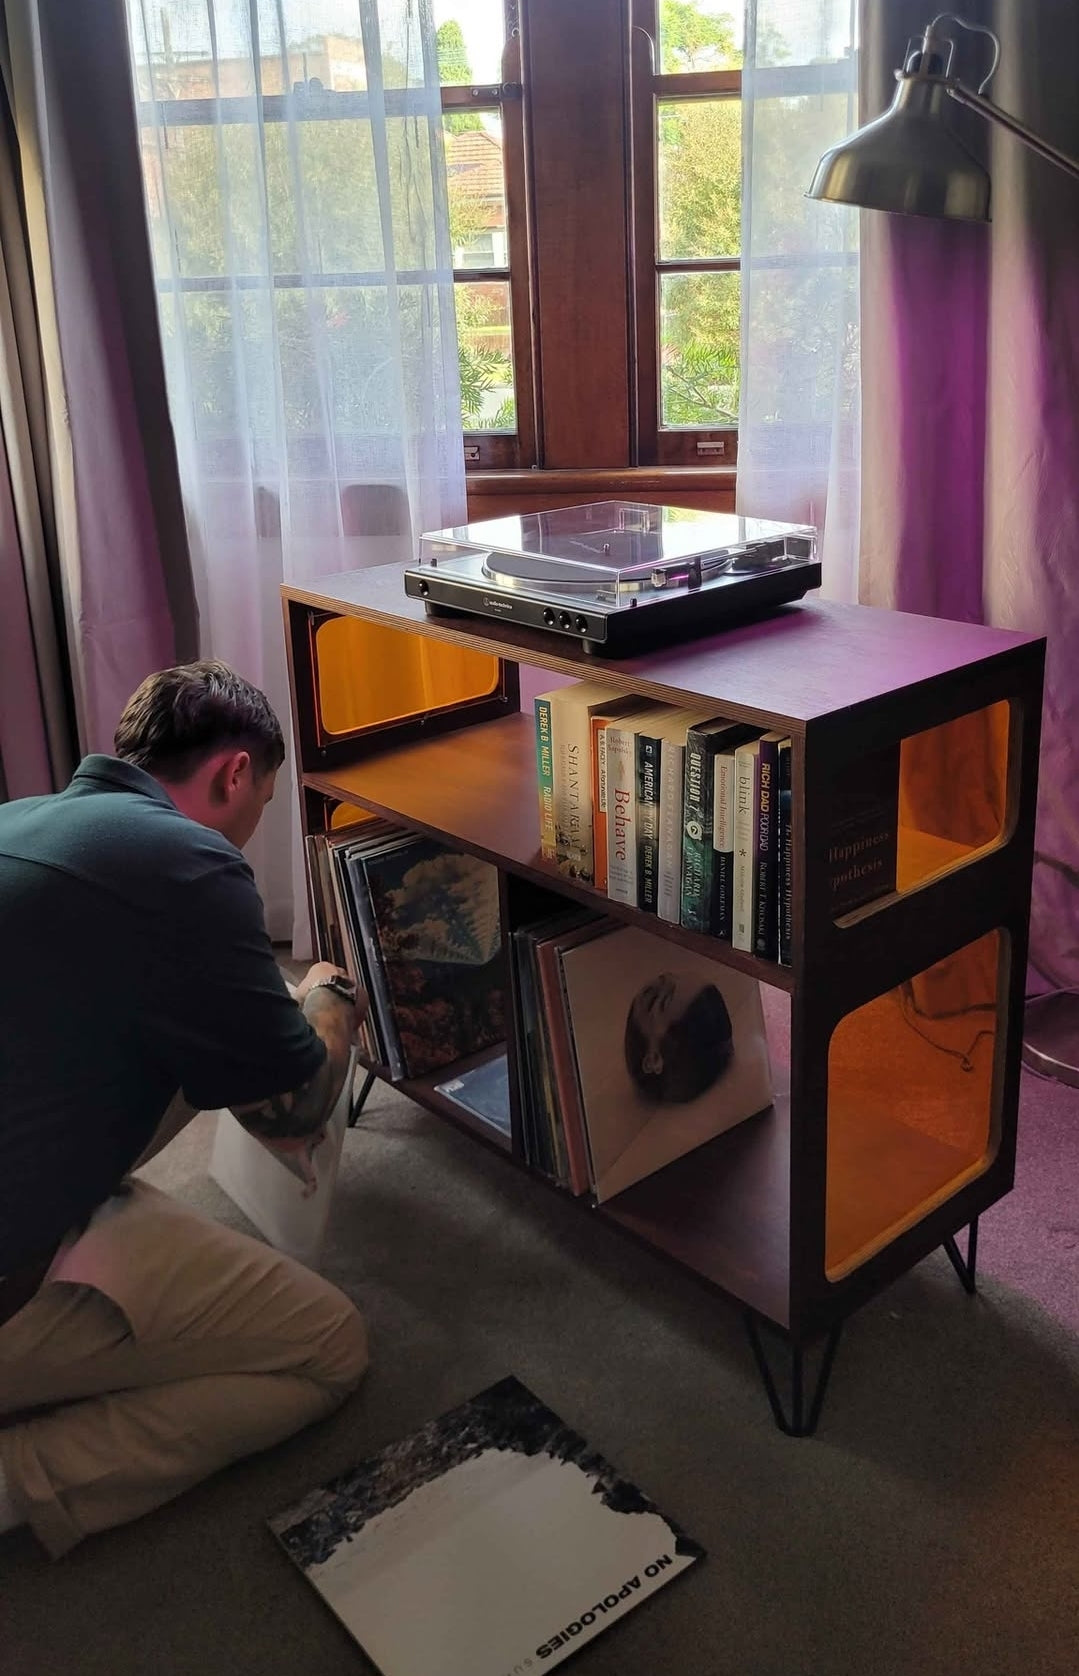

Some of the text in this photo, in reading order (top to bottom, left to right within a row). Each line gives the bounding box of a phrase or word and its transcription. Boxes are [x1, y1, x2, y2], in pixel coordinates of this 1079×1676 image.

[539, 706, 548, 733] DEREK
[542, 745, 551, 776] MILLER
[643, 761, 654, 807] AMERICAN
[666, 746, 675, 800] RICHARD
[689, 752, 702, 803] QUESTION
[543, 786, 553, 830] RADIO LIFE
[717, 765, 728, 849] Emotional Intelligence
[738, 776, 751, 815] blink
[759, 763, 771, 851] RICH DAD POOR DAD
[614, 788, 631, 861] Behave
[644, 822, 653, 840] DAY
[665, 804, 673, 868] FLANAGAN
[644, 845, 653, 868] DEREK
[685, 846, 695, 897] FLANAGAN
[691, 852, 702, 898] RICHARD
[758, 861, 768, 892] ROBERT
[783, 838, 792, 886] Happiness
[644, 877, 653, 904] MILLER
[719, 856, 727, 921] DANIEL GOLEMAN
[782, 888, 792, 940] Hypothesis
[644, 1554, 673, 1577] NO
[536, 1575, 642, 1659] APOLOGIES
